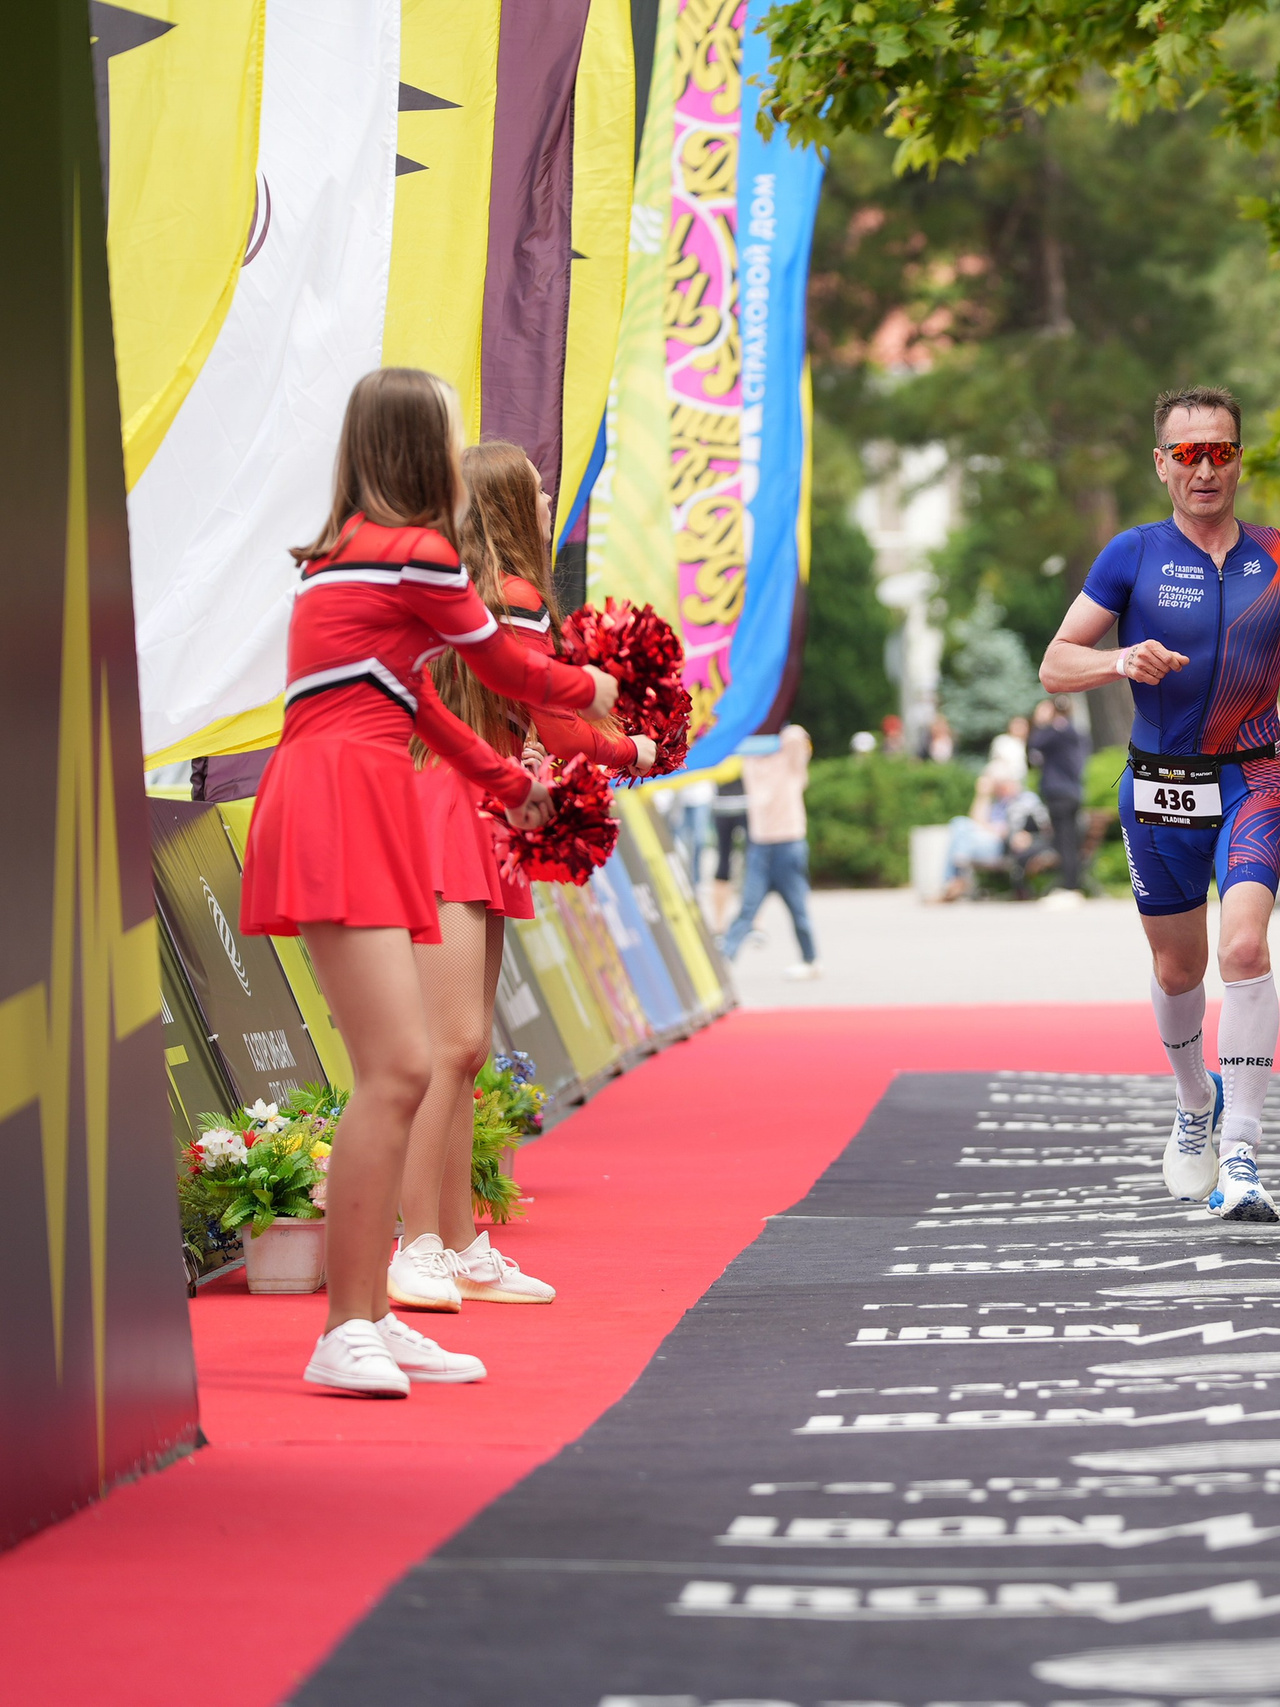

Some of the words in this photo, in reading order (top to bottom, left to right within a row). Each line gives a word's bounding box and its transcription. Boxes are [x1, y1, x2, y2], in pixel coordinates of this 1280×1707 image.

[748, 173, 777, 241] ДОМ
[1175, 565, 1204, 574] ГАЗПРОМ
[1158, 584, 1204, 596] КОМАНДА
[1158, 592, 1201, 602] ГАЗПРОМ
[1158, 599, 1191, 609] НЕФТИ
[1153, 788, 1196, 812] 436
[1162, 815, 1191, 824] VLADIMIR
[891, 1256, 1141, 1273] IRON
[856, 1324, 1141, 1341] IRON
[804, 1406, 1136, 1429] IRON
[727, 1515, 1125, 1539] IRON
[679, 1581, 1118, 1611] IRON
